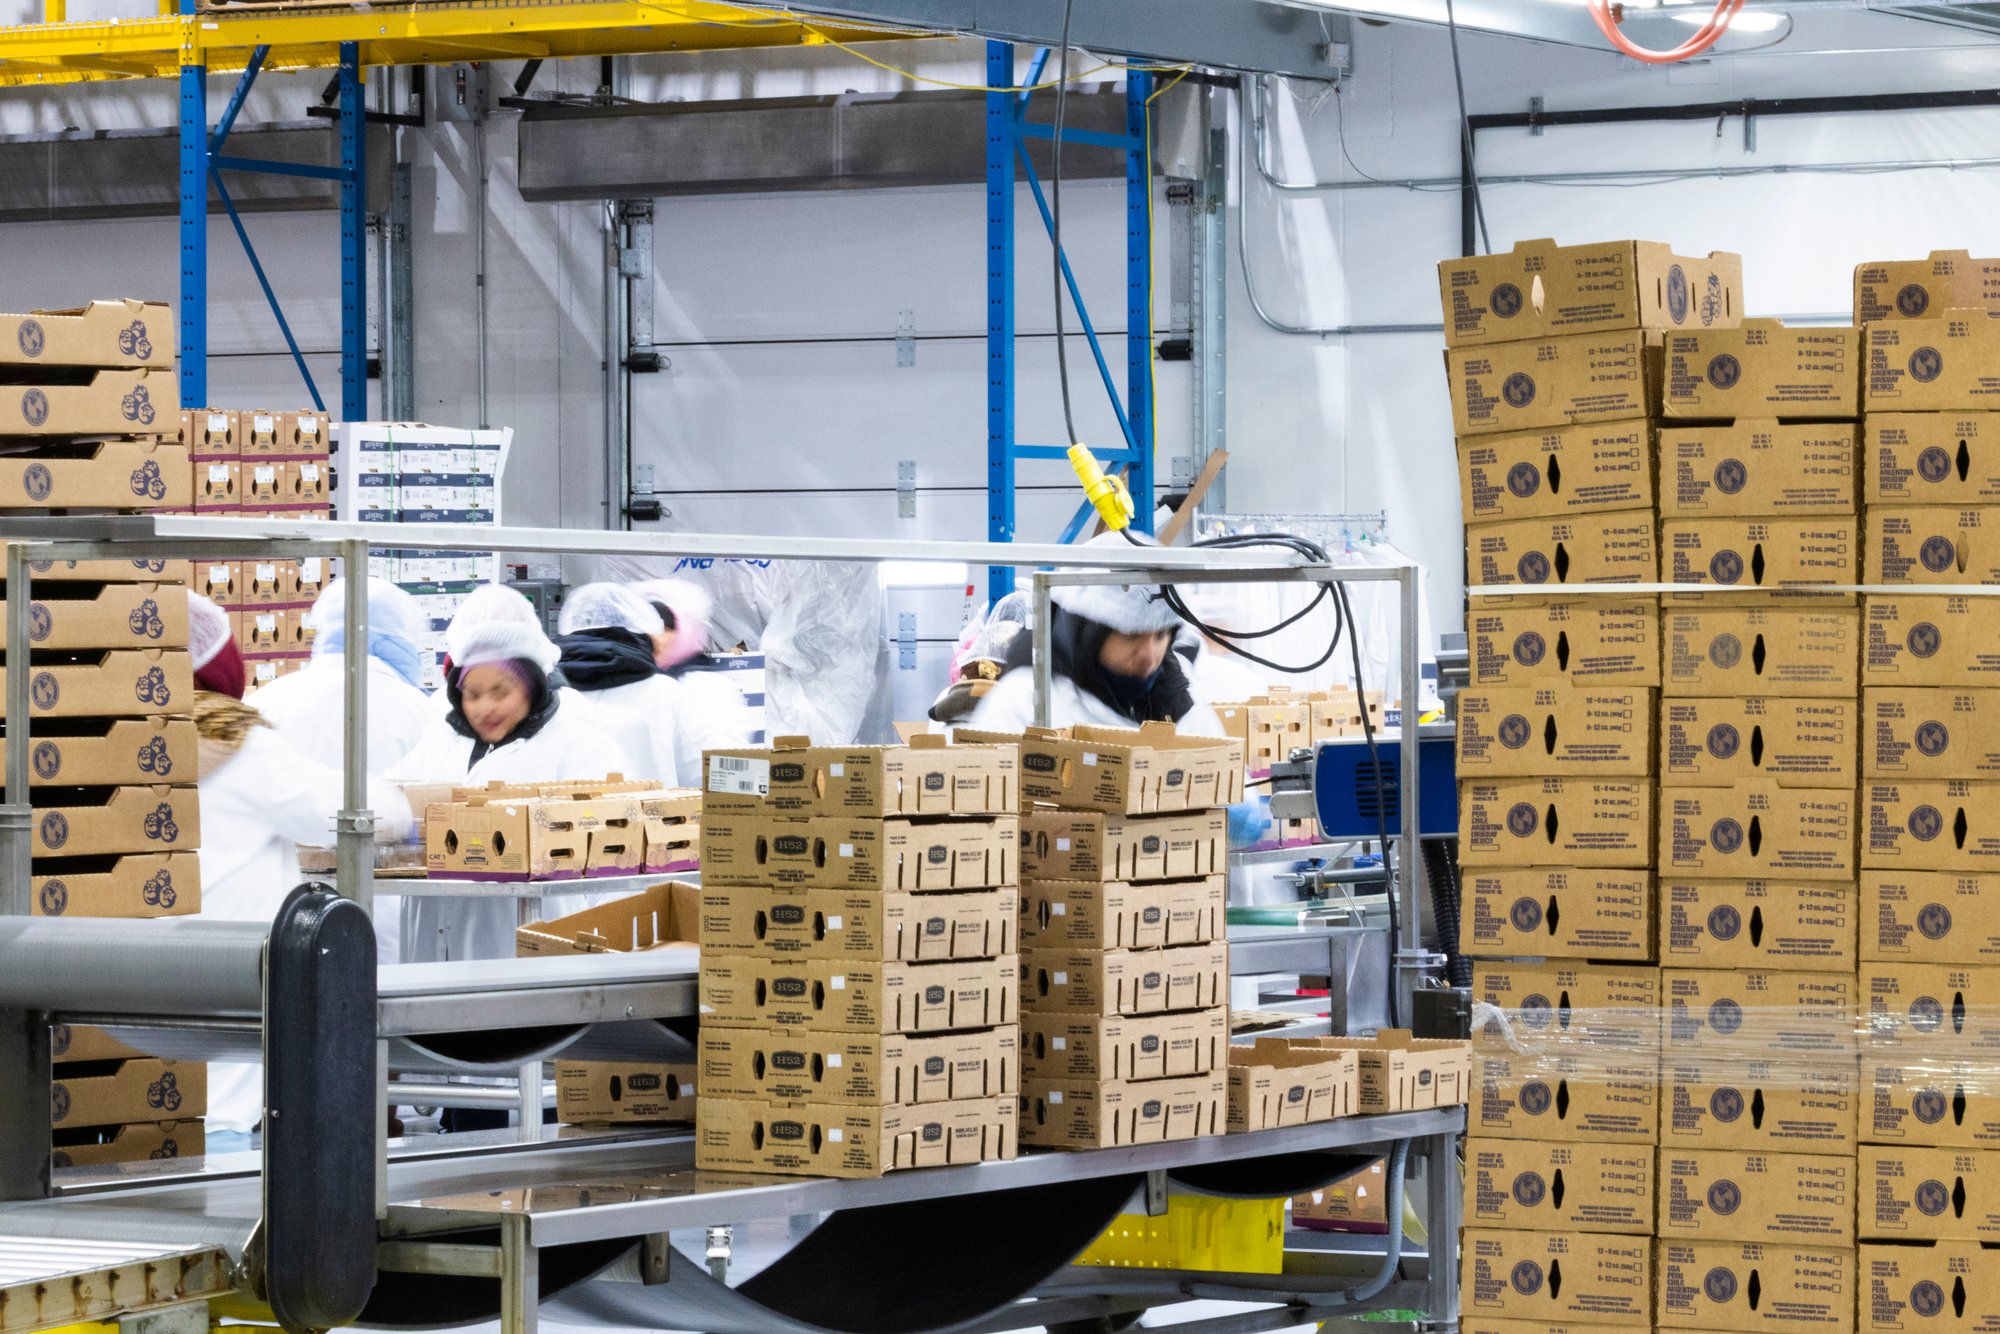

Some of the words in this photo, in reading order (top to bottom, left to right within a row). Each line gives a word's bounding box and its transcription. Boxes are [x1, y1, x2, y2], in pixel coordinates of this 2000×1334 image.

[1454, 306, 1487, 316] ARGENTINA
[1454, 314, 1481, 322] URUGUAY
[1455, 321, 1478, 329] MEXICO
[1472, 485, 1504, 494] ARGENTINA
[1028, 758, 1051, 767] H52
[775, 766, 800, 777] H52
[778, 840, 803, 850] H52
[930, 850, 945, 859] H52
[775, 910, 800, 920] H52
[928, 922, 943, 930] H52
[776, 982, 802, 992] H52
[928, 990, 943, 1000] H52
[776, 1056, 801, 1066] H52
[926, 1062, 942, 1071] H52
[632, 1078, 656, 1086] H52
[774, 1126, 800, 1136] H52
[924, 1128, 940, 1138] H52
[1667, 1286, 1700, 1294] ARGENTINA
